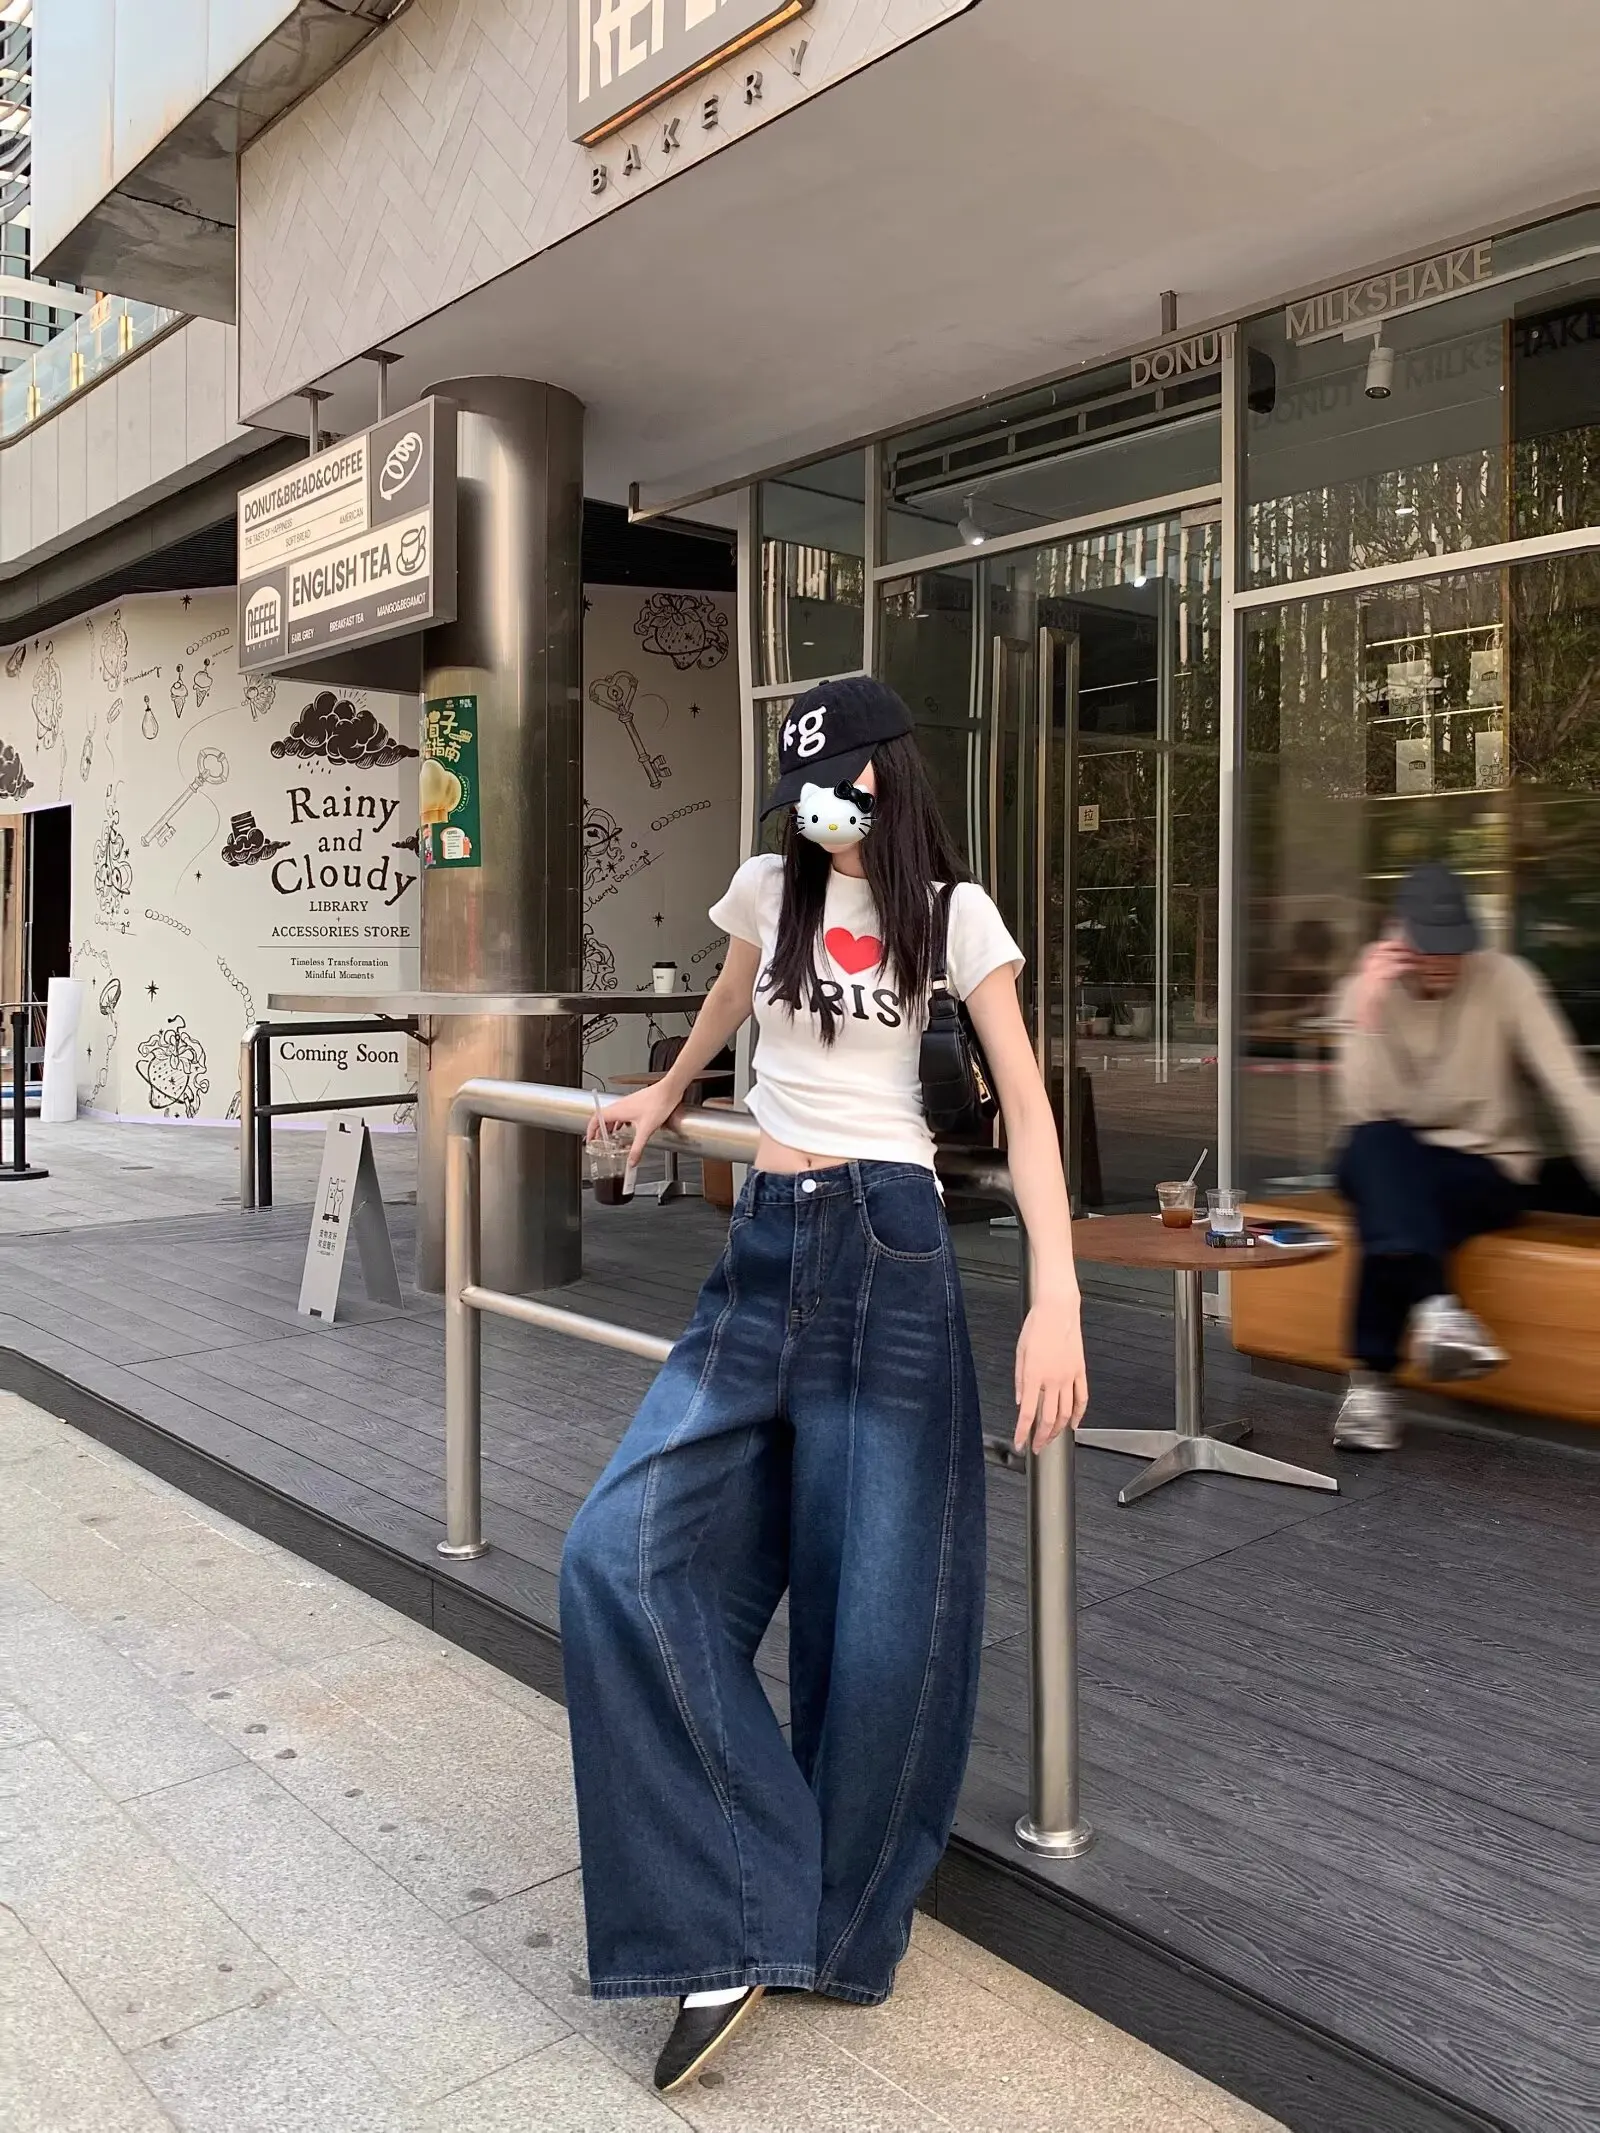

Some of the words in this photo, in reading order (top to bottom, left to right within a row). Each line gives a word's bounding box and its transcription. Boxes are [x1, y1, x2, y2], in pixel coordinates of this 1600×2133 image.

[591, 40, 807, 194] BAKERY
[1285, 239, 1493, 340] MILKSHAKE
[1130, 322, 1239, 389] DONUT
[244, 449, 363, 524] DONUT&BREAD&COFFEE
[292, 554, 357, 607] ENGLISH
[360, 542, 392, 583] TEA
[247, 600, 279, 641] REFEEL
[291, 632, 302, 644] EARL
[302, 628, 315, 641] GREY
[329, 615, 354, 633] BREAKFAST
[355, 612, 365, 624] TEA
[286, 786, 400, 833] Rainy
[318, 828, 362, 853] and
[271, 854, 417, 906] Cloudy
[309, 900, 369, 912] LIBRARY
[271, 926, 359, 938] ACCESSORIES
[363, 926, 410, 938] STORE
[290, 957, 325, 967] Timeless
[327, 957, 389, 967] Transformation
[305, 970, 336, 980] Mindful
[339, 970, 374, 980] Moments
[280, 1041, 348, 1070] Coming
[356, 1043, 399, 1063] Soon
